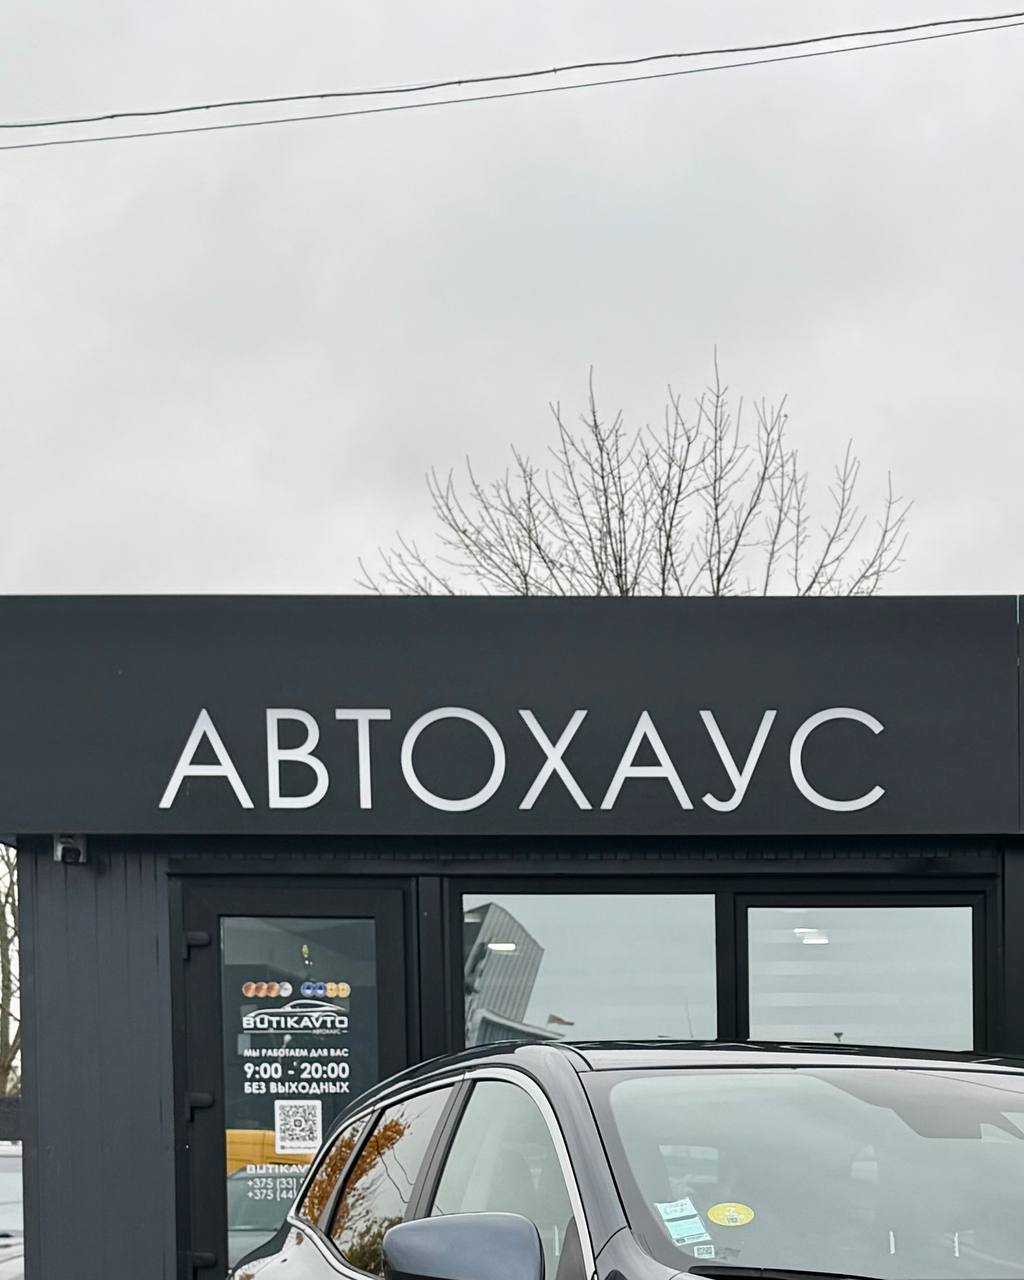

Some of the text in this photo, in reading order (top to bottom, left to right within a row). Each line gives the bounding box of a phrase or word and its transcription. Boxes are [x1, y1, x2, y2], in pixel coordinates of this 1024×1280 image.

[158, 706, 886, 813] АВТОХАУС
[242, 1016, 349, 1029] BUTIKAVTO
[244, 1048, 349, 1058] МЫ РАБОТАЕМ ДЛЯ ВАС
[243, 1062, 283, 1080] 9:00
[299, 1062, 350, 1079] 20:00
[244, 1081, 350, 1094] БЕЗ ВЫХОДНЫХ
[246, 1163, 312, 1174] BUTIKAV
[247, 1178, 274, 1188] +375
[276, 1178, 297, 1190] (33)
[247, 1190, 274, 1200] +375
